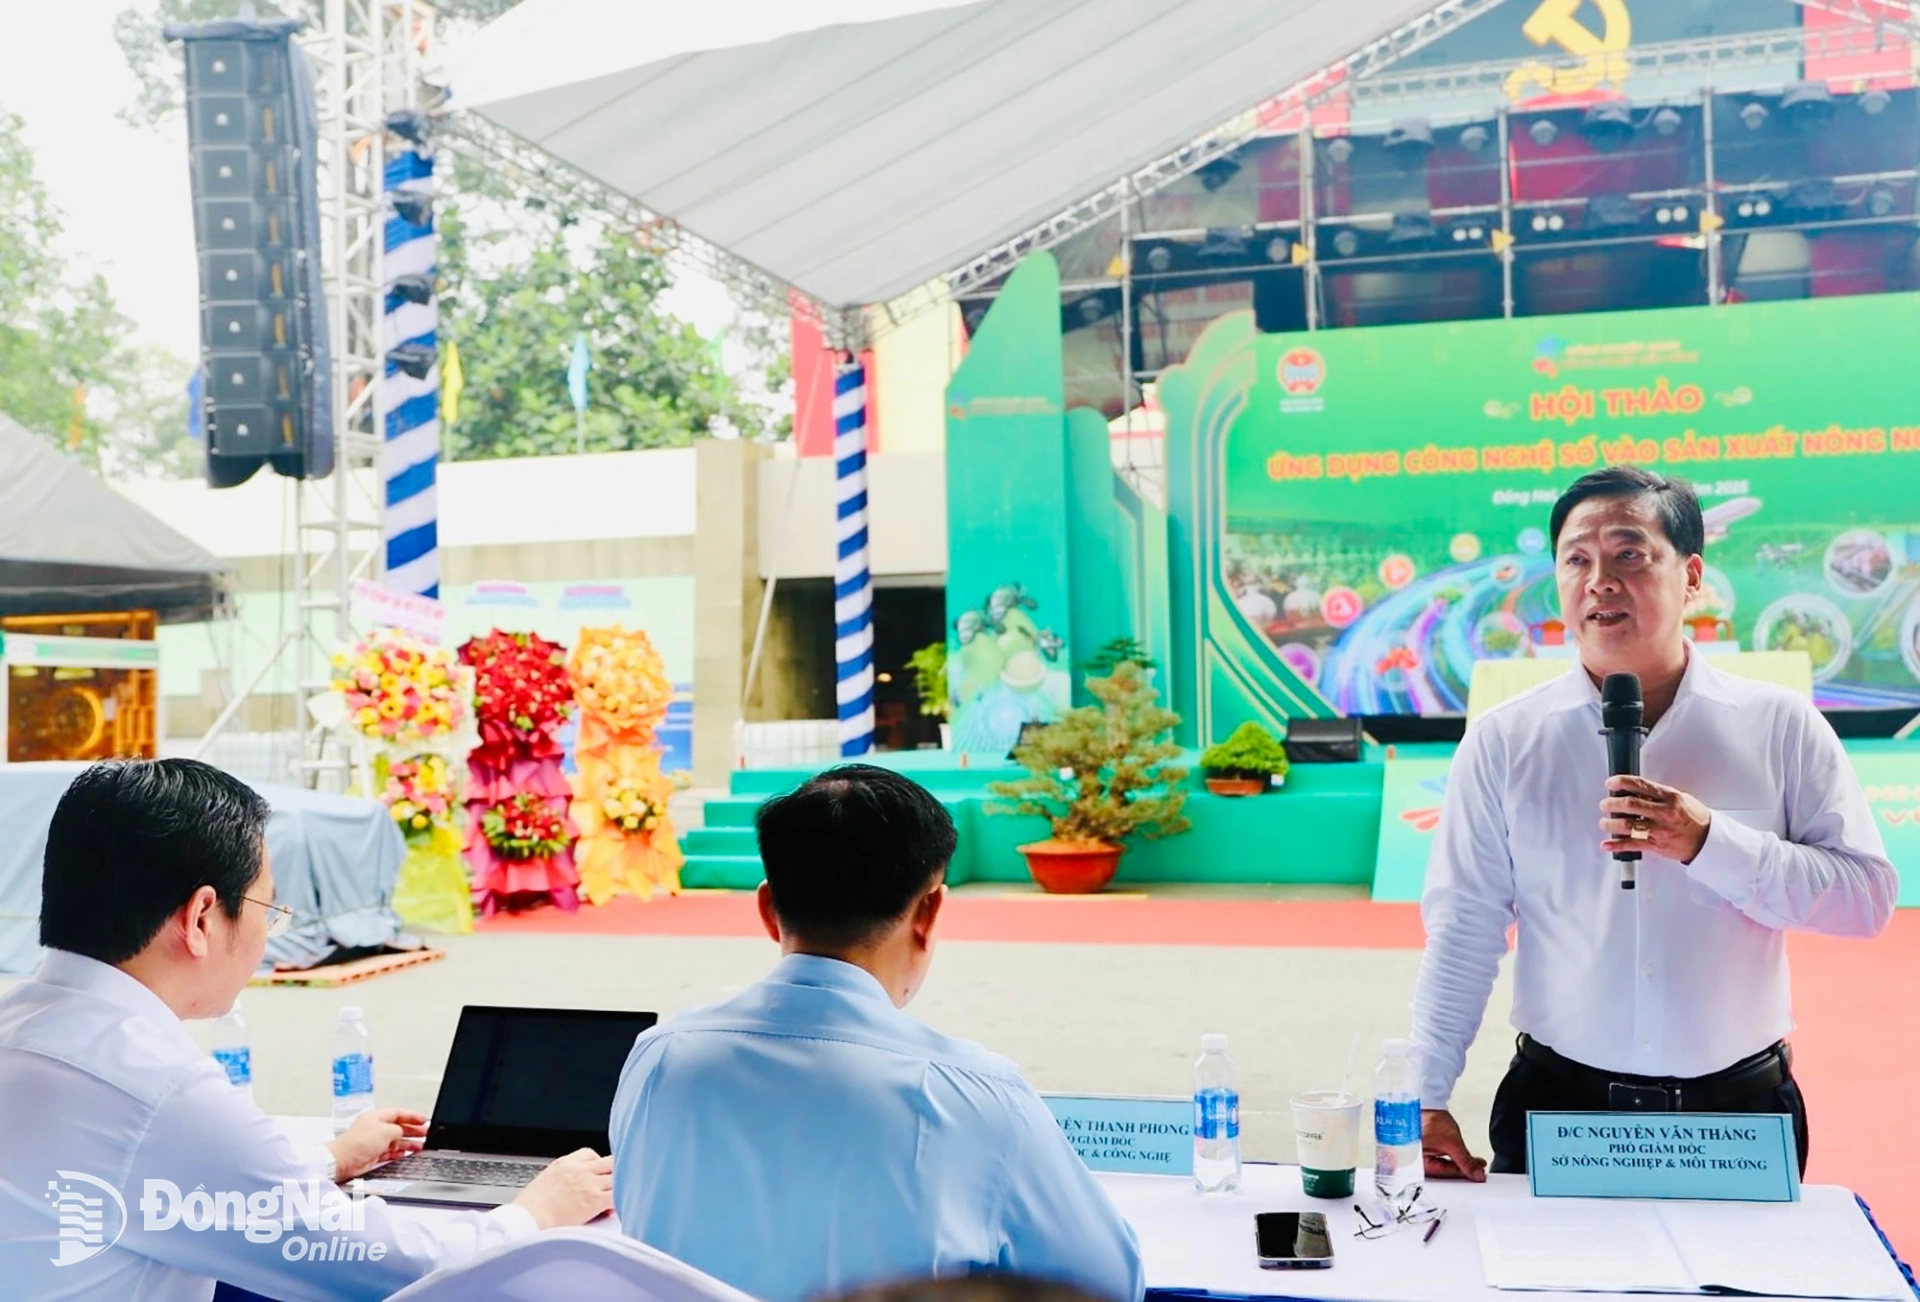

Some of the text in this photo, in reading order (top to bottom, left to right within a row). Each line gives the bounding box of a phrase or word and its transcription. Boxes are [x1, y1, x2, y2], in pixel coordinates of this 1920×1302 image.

[1530, 376, 1704, 426] HỘI THẢO
[1268, 451, 1322, 480] ỨNG
[1326, 452, 1399, 484] DỤNG
[1404, 444, 1477, 475] CÔNG
[1483, 438, 1554, 475] NGHỆ
[1559, 434, 1598, 467] SỐ
[1602, 434, 1659, 465] VÀO
[1663, 430, 1720, 463] SẢN
[1724, 424, 1798, 460] XUẤT
[1802, 424, 1885, 456] NÔNG
[1085, 1119, 1135, 1133] THANH
[1138, 1122, 1190, 1136] PHONG
[1557, 1125, 1584, 1139] Đ/C
[1660, 1124, 1693, 1140] VĂN
[1091, 1148, 1101, 1158] &
[1103, 1147, 1136, 1160] CÔNG
[1139, 1150, 1171, 1163] NGHỆ
[1608, 1141, 1636, 1154] PHÓ
[1572, 1154, 1610, 1168] NÔNG
[1612, 1156, 1662, 1170] NGHIỆP
[1665, 1158, 1676, 1168] &
[1680, 1156, 1706, 1169] MÔI
